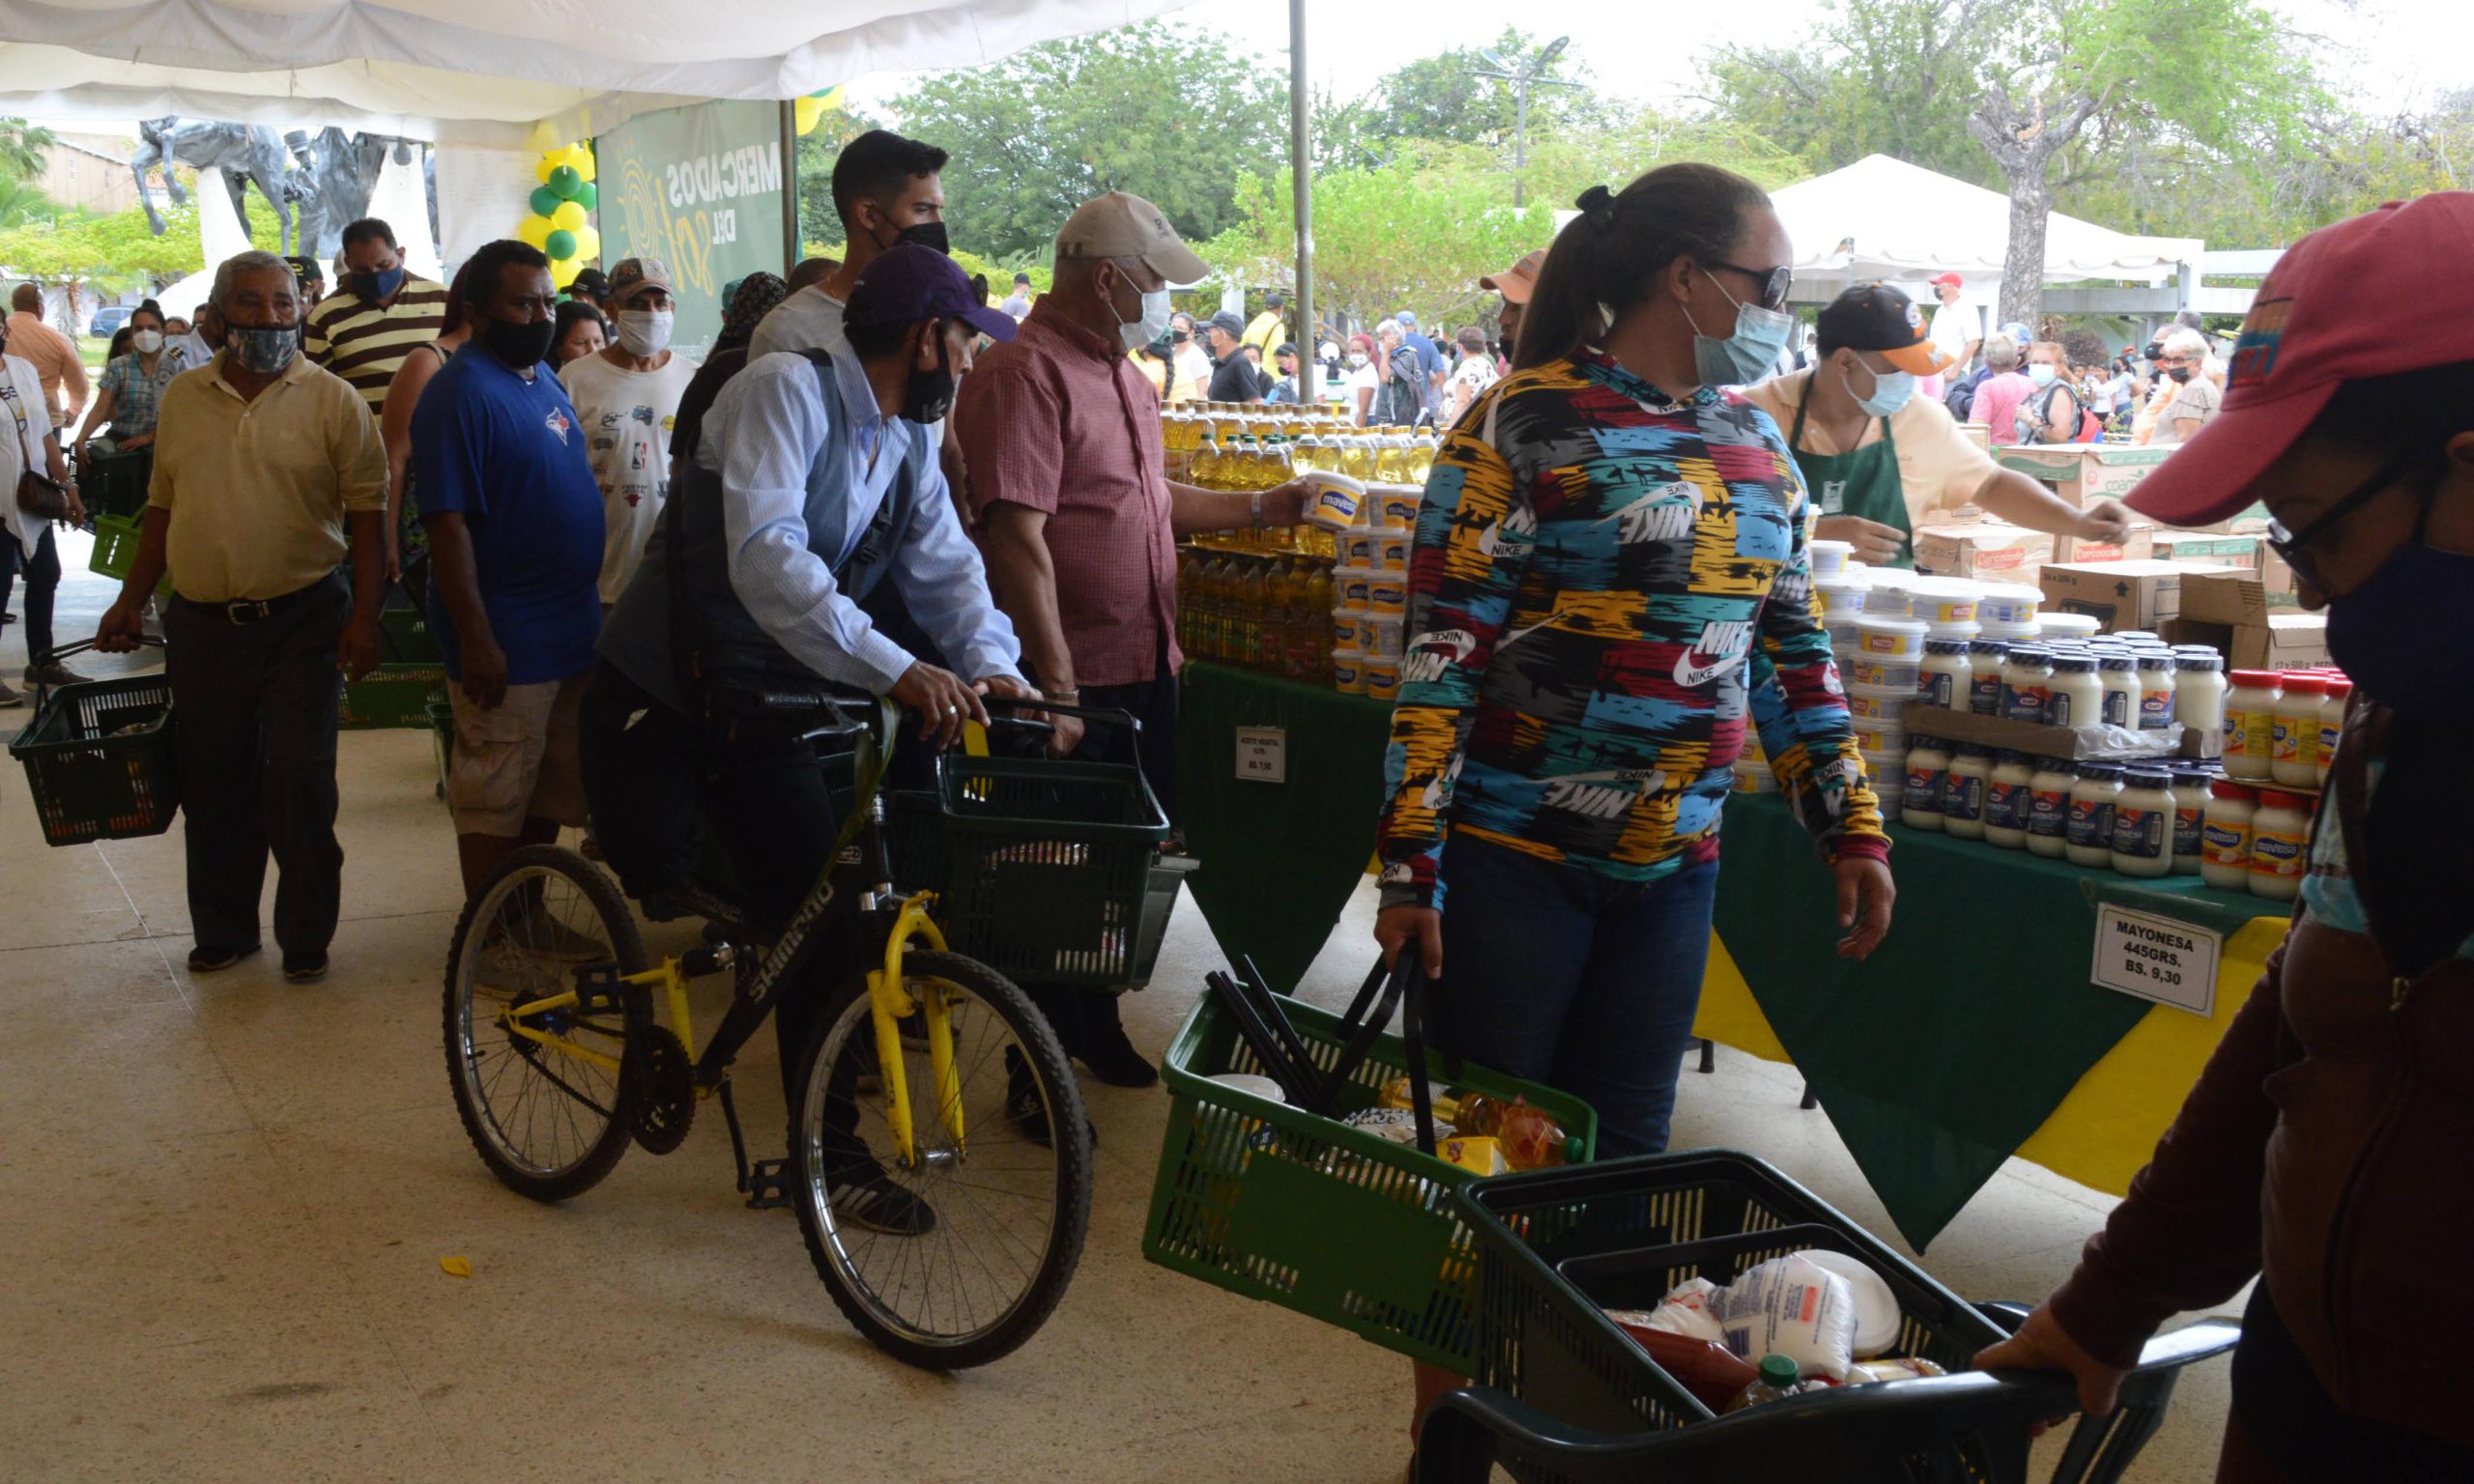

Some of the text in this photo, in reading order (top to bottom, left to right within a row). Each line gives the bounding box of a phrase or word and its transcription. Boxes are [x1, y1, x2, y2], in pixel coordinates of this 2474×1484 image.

[1491, 544, 1524, 556] NIKE
[1694, 621, 1755, 655] NIKE
[1686, 667, 1715, 685] NIKE
[2116, 921, 2194, 953] MAYONESA
[2123, 941, 2181, 967] 445GRS.
[2125, 959, 2181, 985] BS. 9,30
